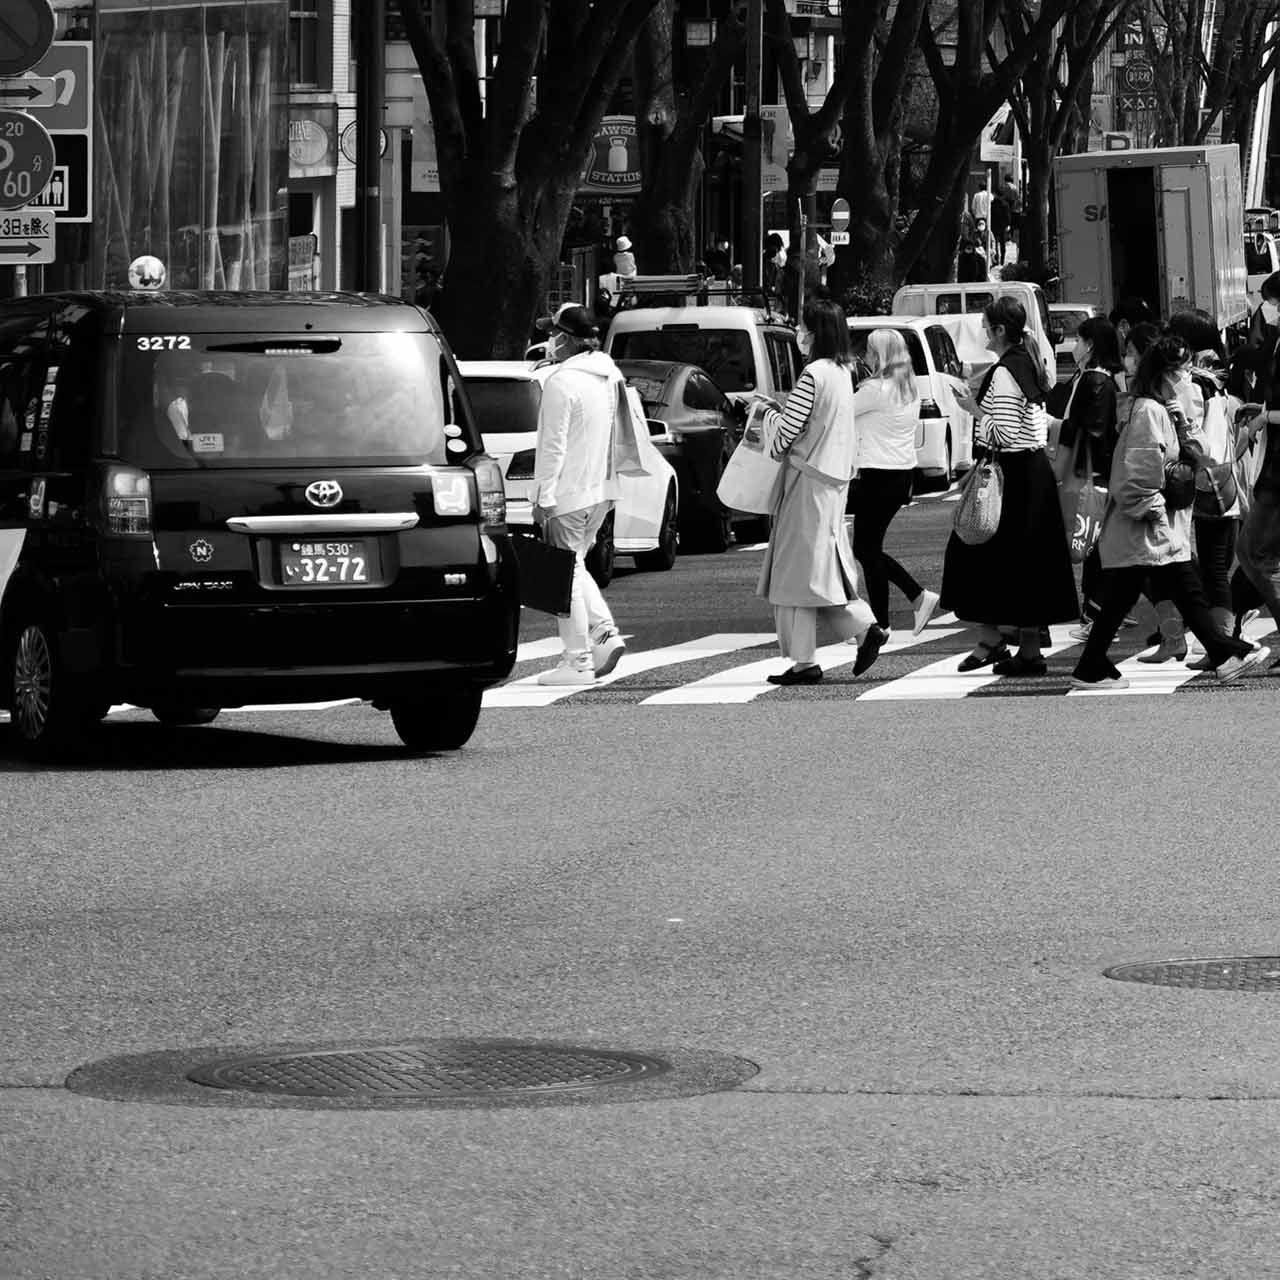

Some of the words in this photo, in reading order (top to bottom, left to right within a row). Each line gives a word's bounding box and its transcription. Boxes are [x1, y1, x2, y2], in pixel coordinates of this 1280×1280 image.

[593, 125, 639, 138] AWSO
[3, 170, 31, 198] 60
[0, 218, 49, 235] 3日を除く
[136, 335, 192, 351] 3272
[326, 544, 350, 556] 530
[300, 557, 367, 582] 32-72
